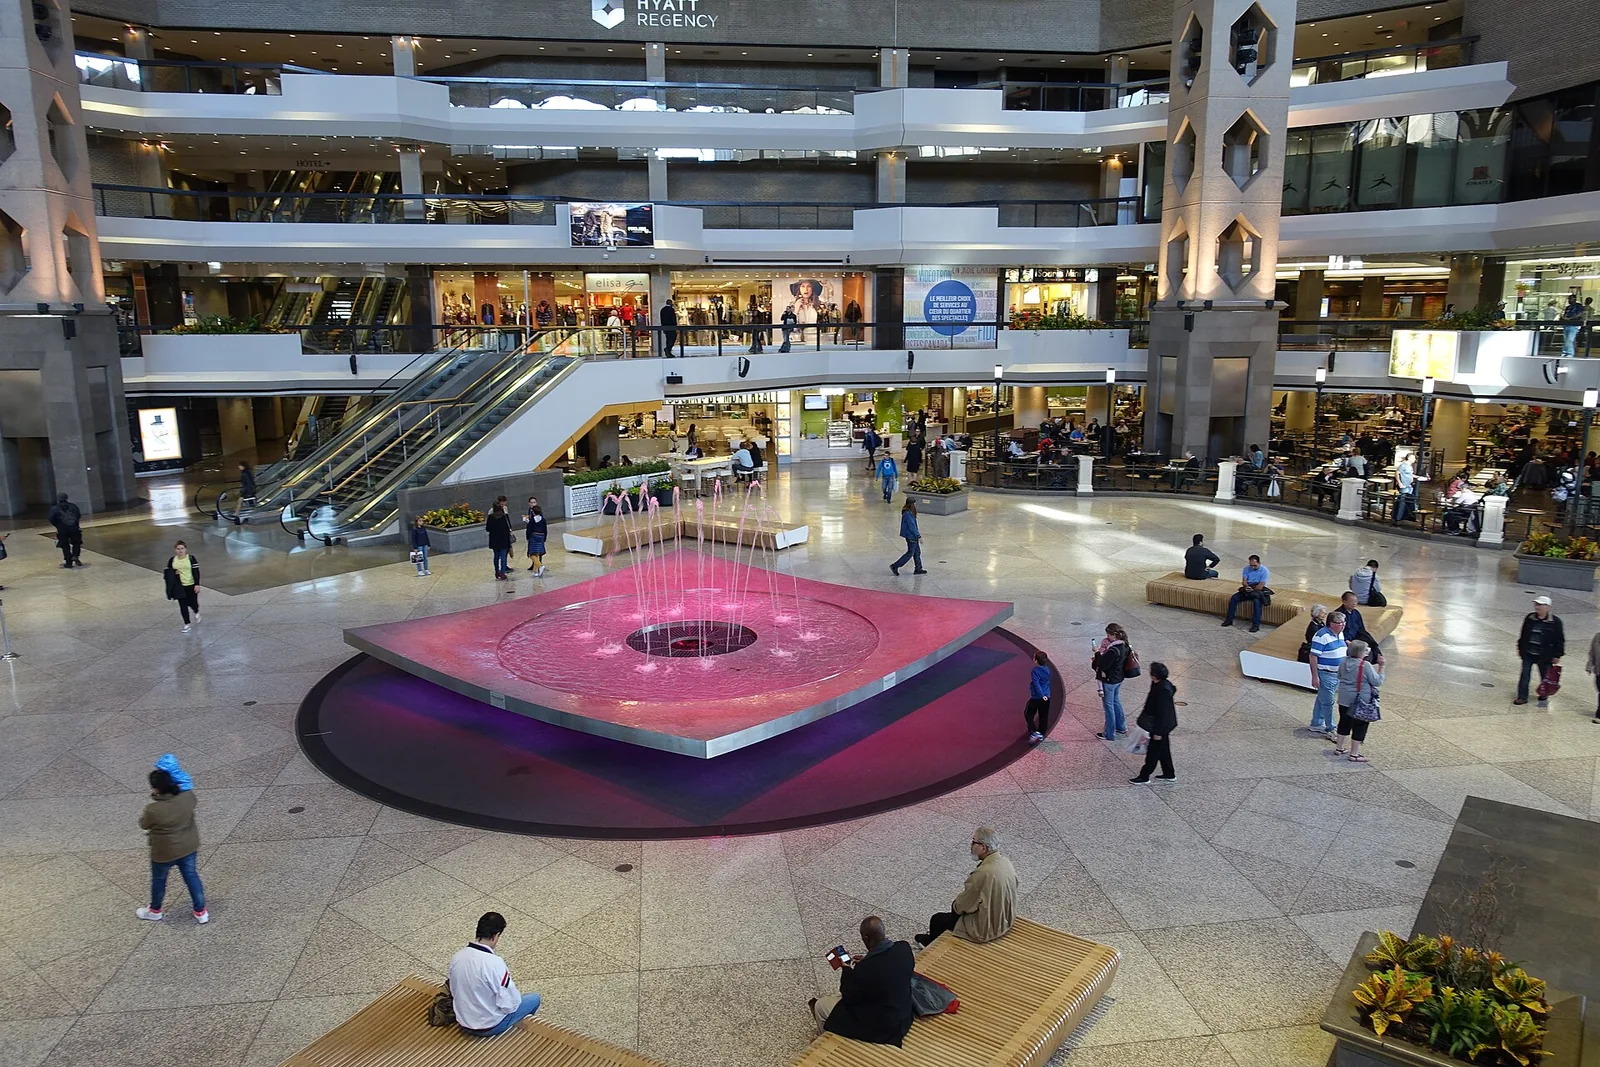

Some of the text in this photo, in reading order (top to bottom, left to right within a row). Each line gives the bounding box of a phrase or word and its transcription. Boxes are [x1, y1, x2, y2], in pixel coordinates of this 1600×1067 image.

[637, 0, 699, 11] HYATT
[637, 13, 719, 28] REGENCY
[296, 159, 324, 168] HÔTEL
[595, 278, 621, 288] elisa
